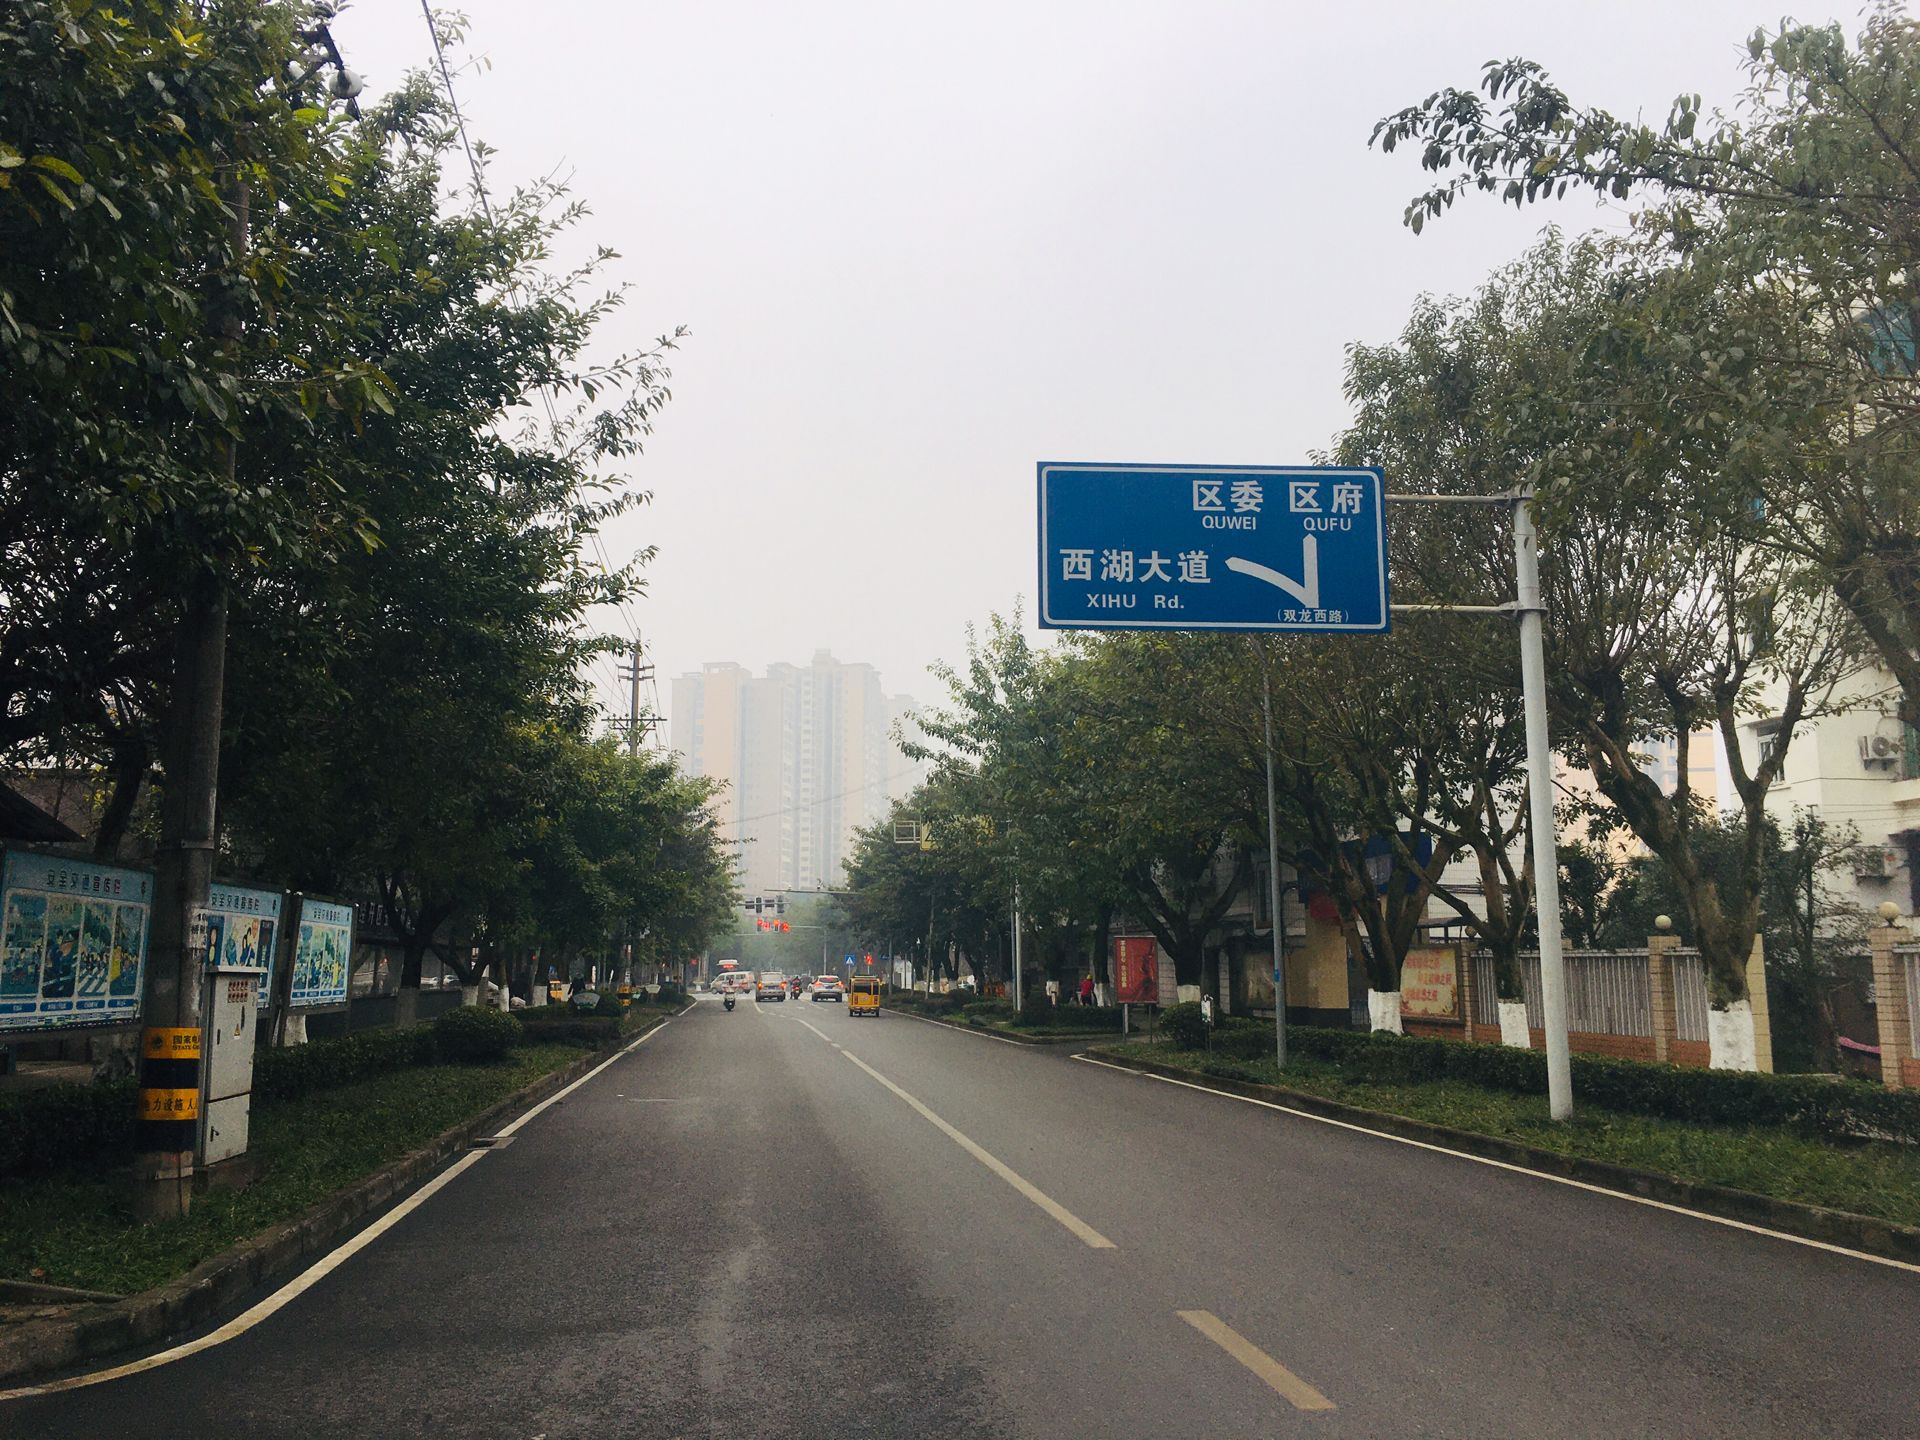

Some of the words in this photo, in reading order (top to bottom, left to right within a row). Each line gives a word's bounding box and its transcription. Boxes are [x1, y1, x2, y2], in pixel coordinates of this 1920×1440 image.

[1192, 480, 1264, 513] 区委
[1289, 481, 1364, 515] 区府
[1202, 515, 1257, 531] QUWEI
[1303, 516, 1352, 532] QUFU
[1059, 549, 1211, 584] 西湖大道
[1086, 594, 1137, 609] XIHU
[1154, 595, 1185, 610] Rd.
[1277, 608, 1350, 625] (双龙西路)
